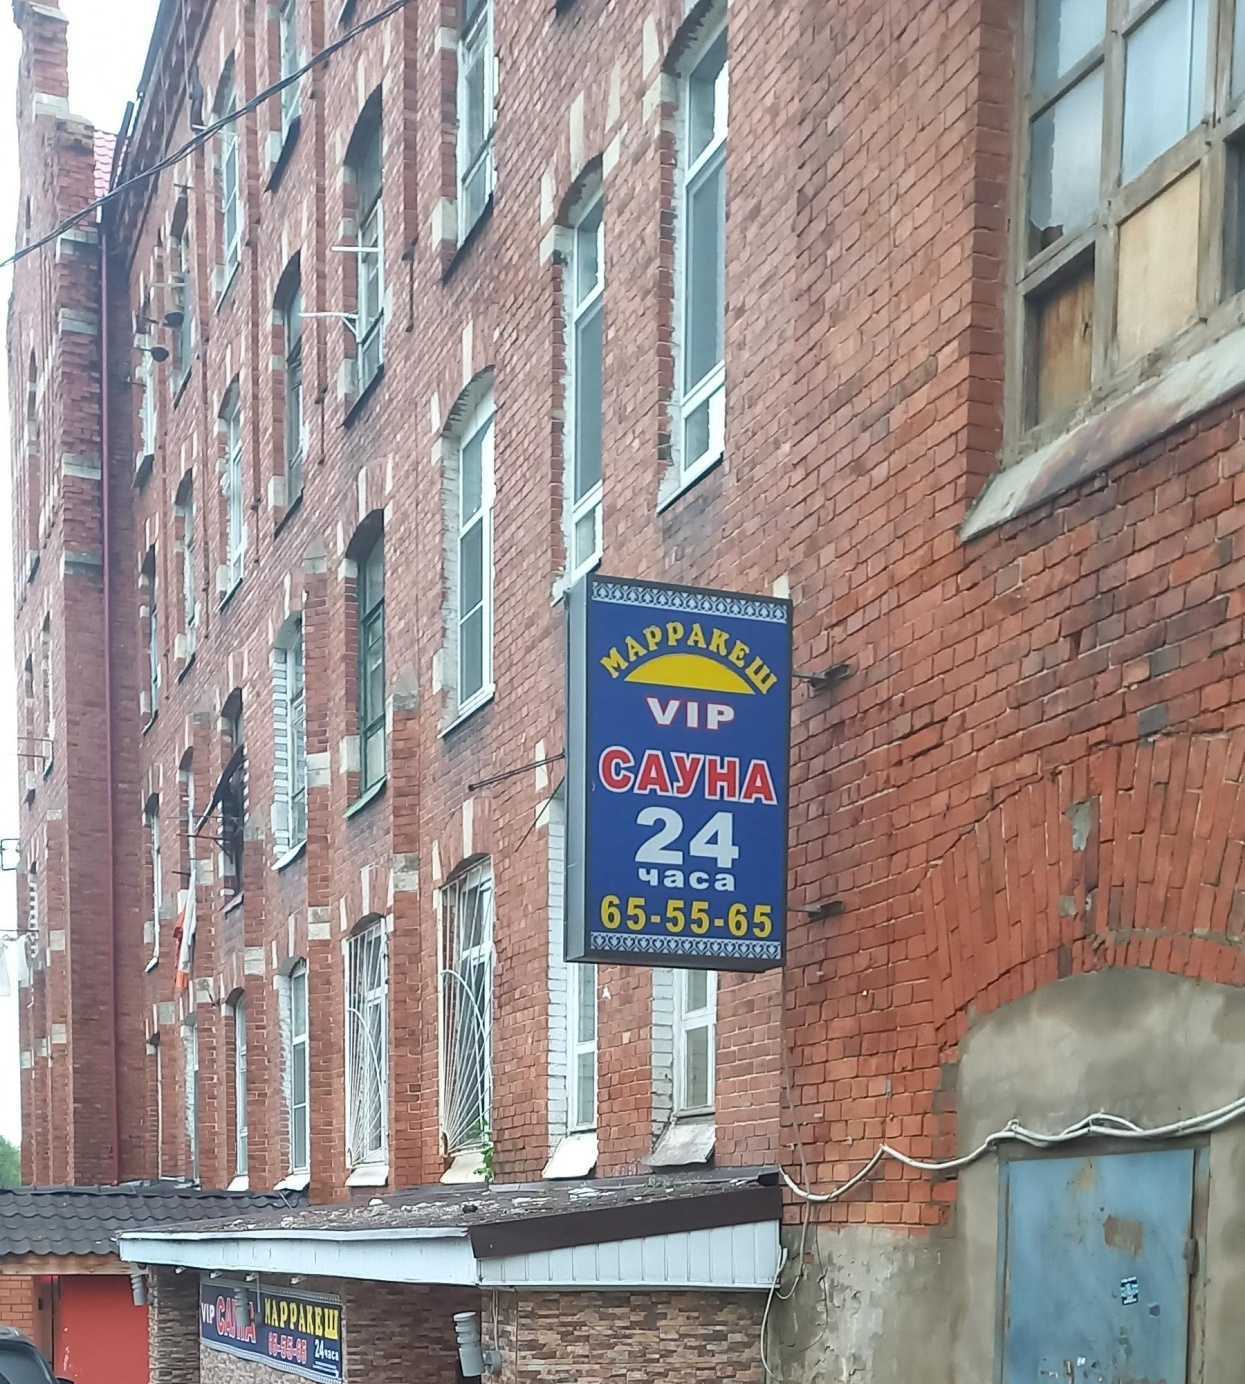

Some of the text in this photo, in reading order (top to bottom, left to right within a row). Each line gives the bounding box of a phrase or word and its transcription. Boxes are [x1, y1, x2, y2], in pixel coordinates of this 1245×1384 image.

[599, 621, 779, 695] МАРРАКЕШ
[646, 697, 735, 730] VIP
[599, 746, 778, 805] САУНА
[634, 806, 740, 868] 24
[638, 868, 736, 892] часа
[600, 894, 774, 938] 65-55-65
[201, 1302, 215, 1324] VIP
[264, 1297, 339, 1340] МАРРАКЕШ
